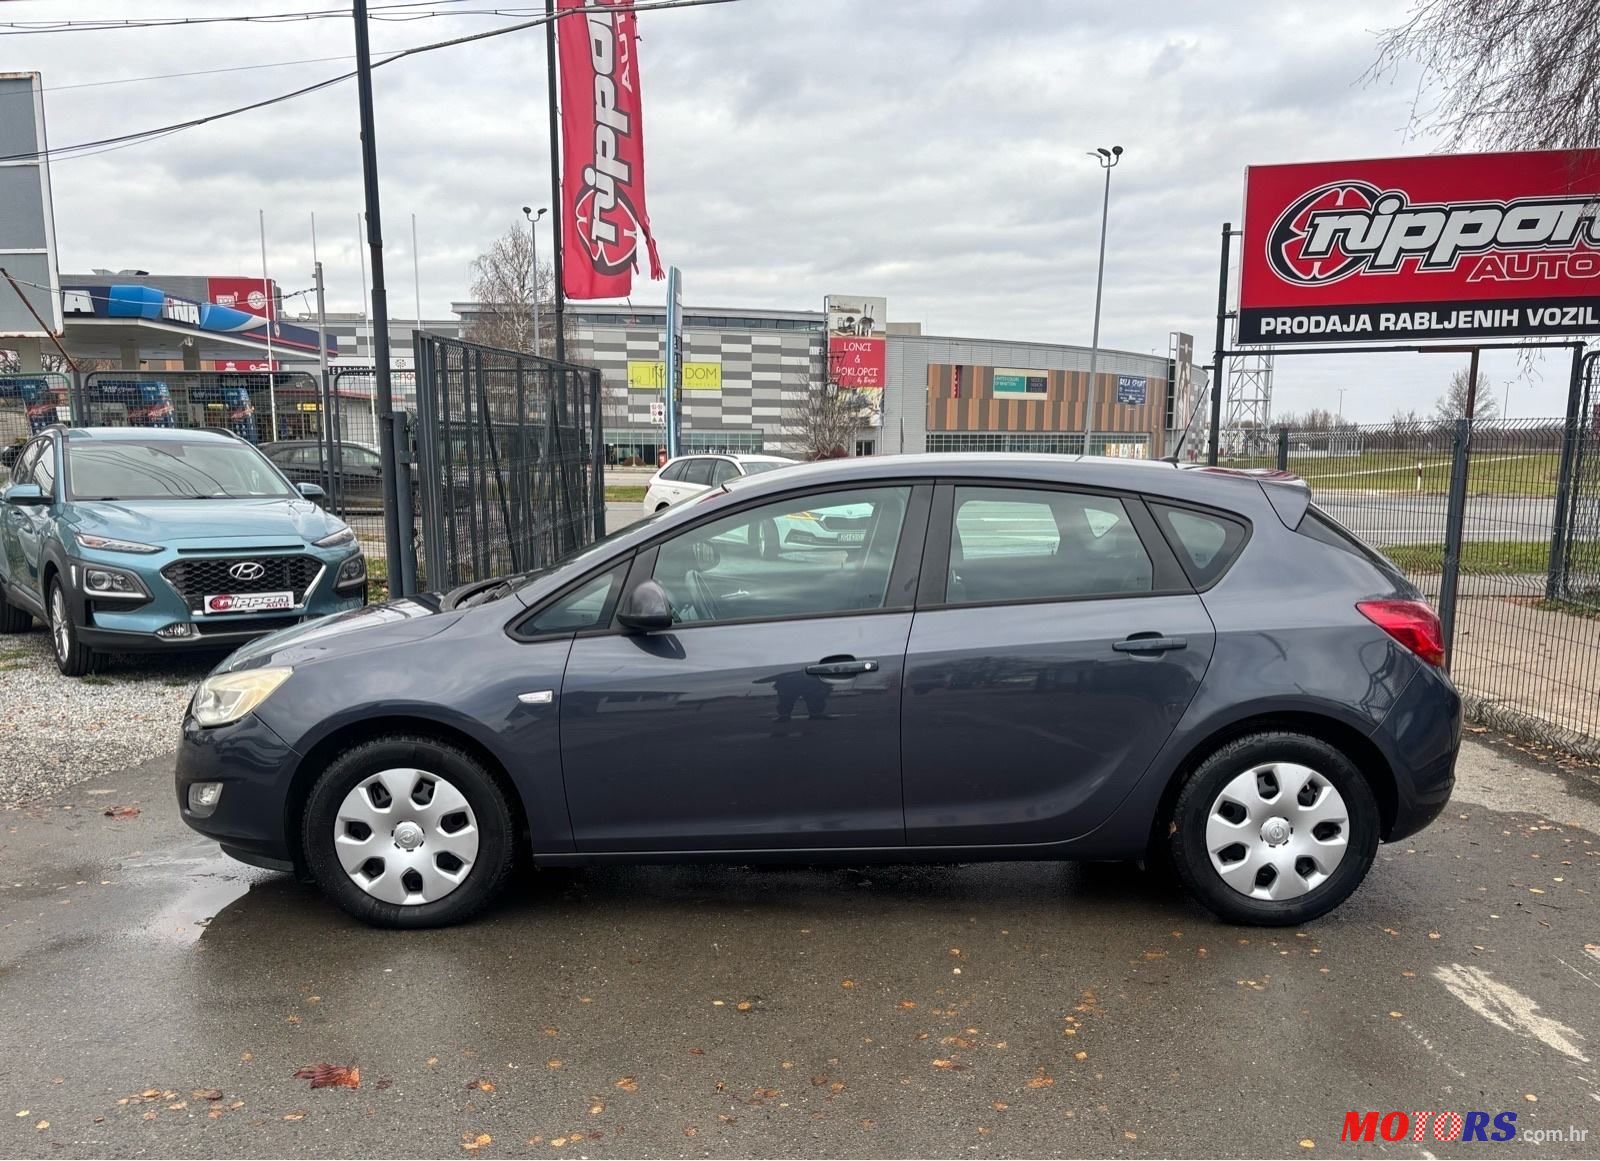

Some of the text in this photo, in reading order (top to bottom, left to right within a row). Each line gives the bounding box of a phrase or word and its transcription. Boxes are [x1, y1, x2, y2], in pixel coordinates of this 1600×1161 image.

[614, 0, 632, 92] AUT
[1467, 252, 1600, 283] AUTO
[1260, 307, 1600, 335] PRODAJA RABLJENIH VOZIL
[844, 341, 872, 352] LONCI
[854, 354, 861, 364] &
[685, 367, 717, 380] DOM
